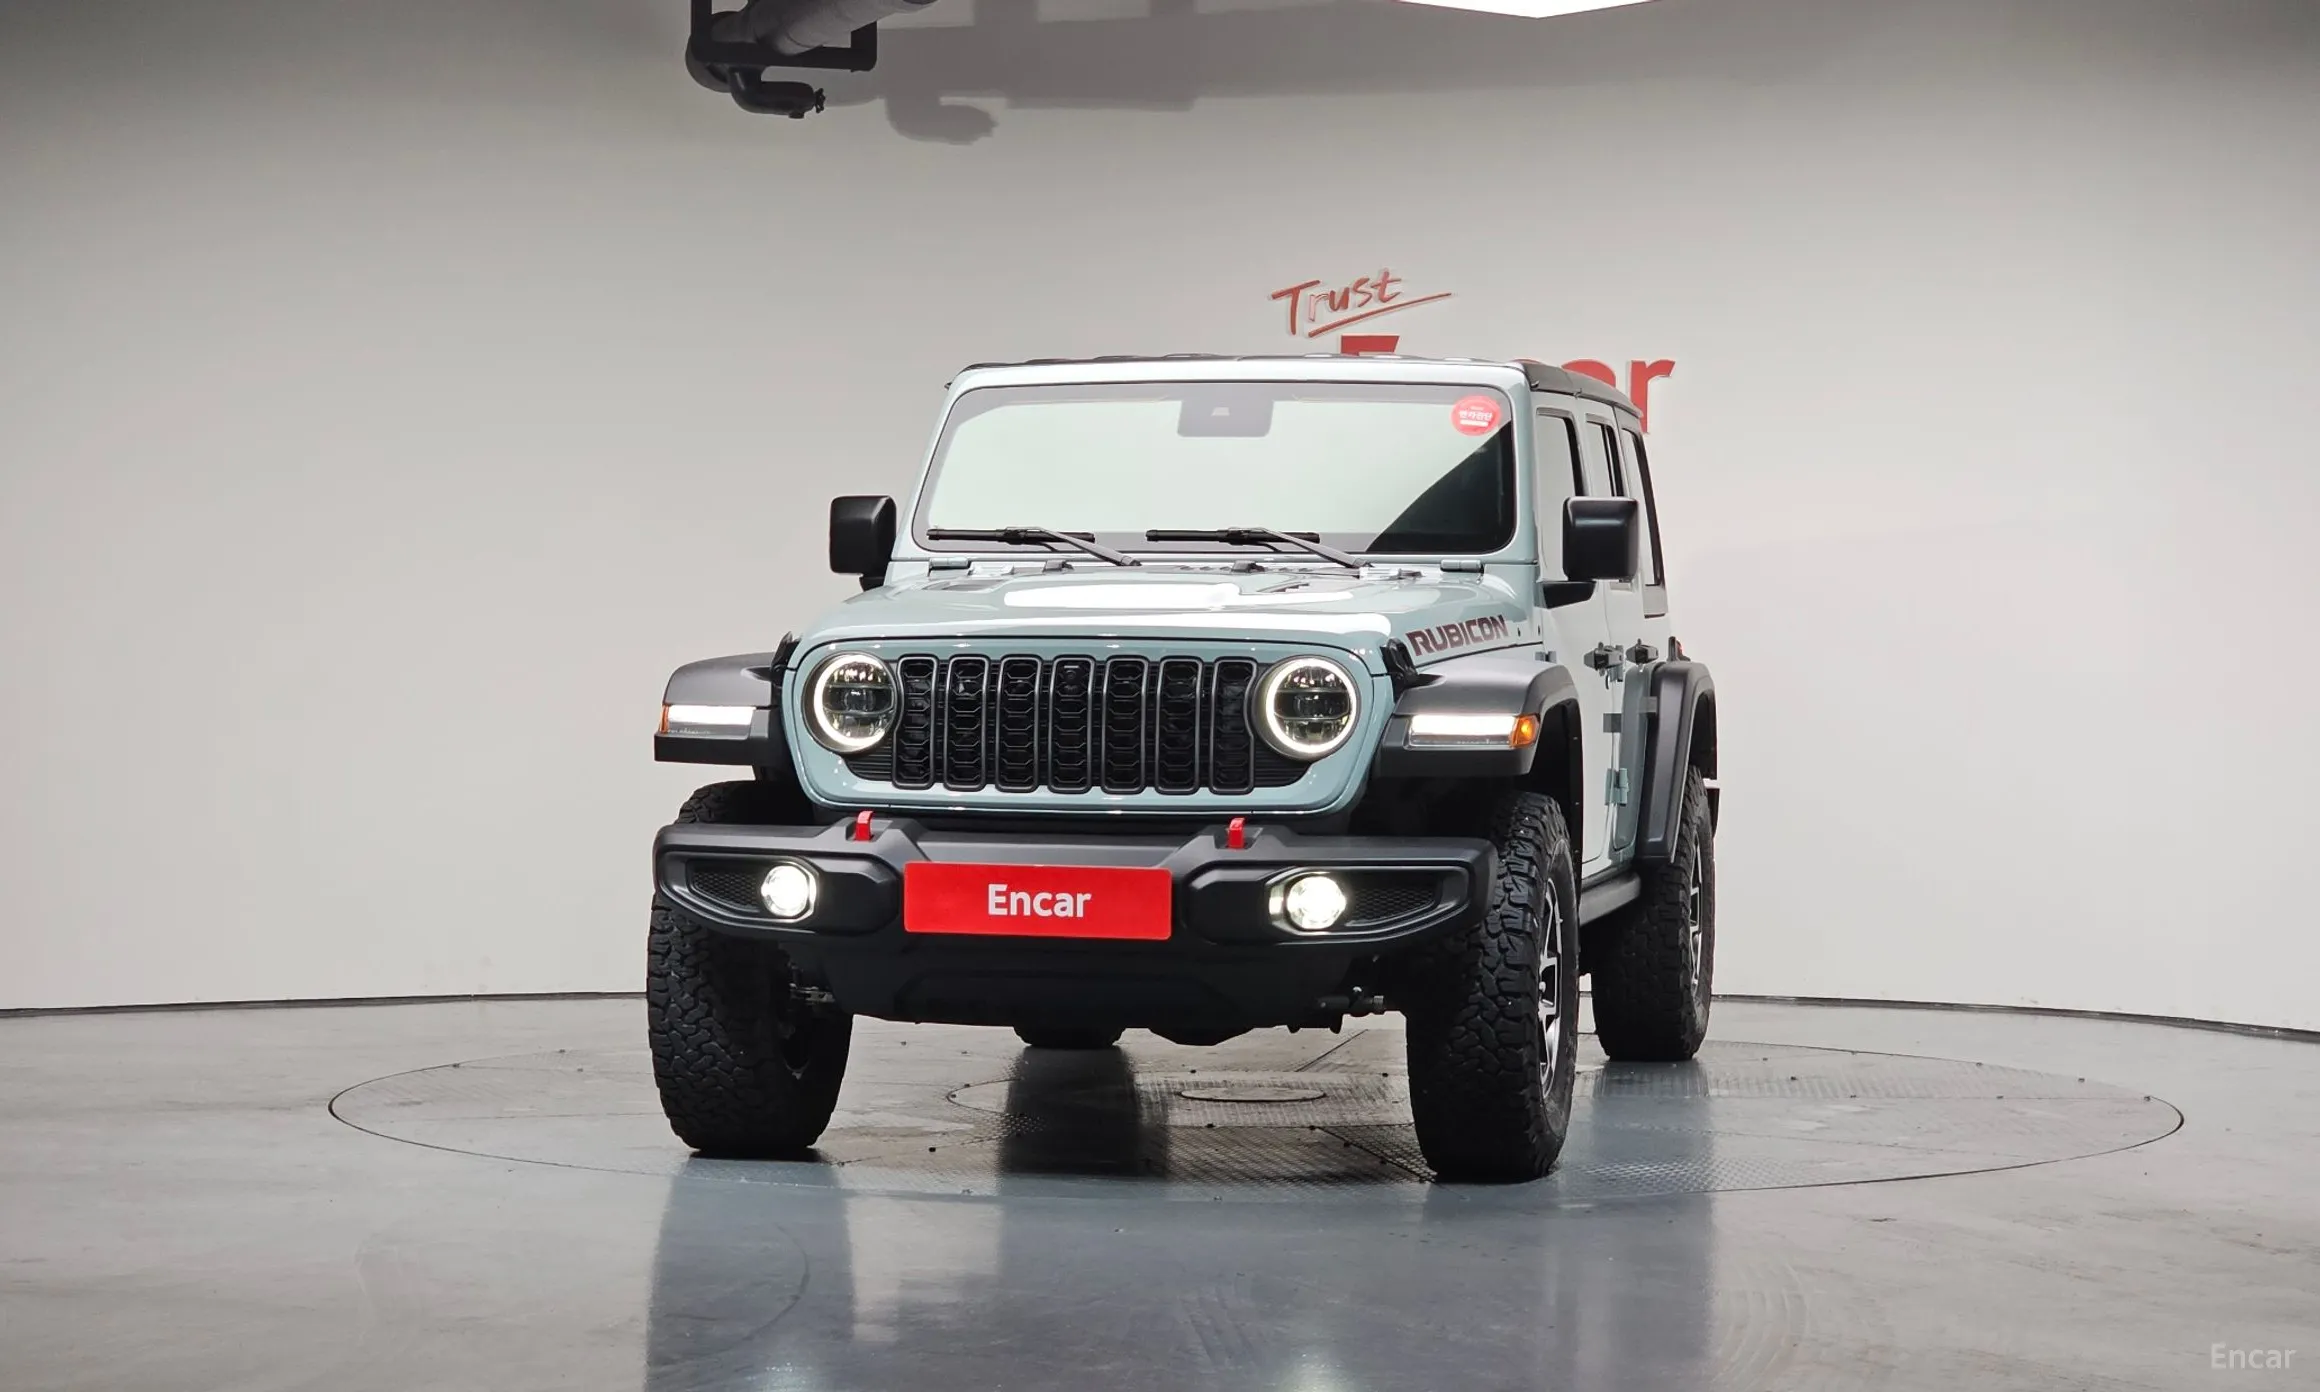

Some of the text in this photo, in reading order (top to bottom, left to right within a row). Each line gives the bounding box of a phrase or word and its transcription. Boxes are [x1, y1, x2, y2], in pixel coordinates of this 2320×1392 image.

[1271, 269, 1402, 336] Trust
[1405, 614, 1509, 656] RUBICON
[988, 883, 1092, 918] Encar
